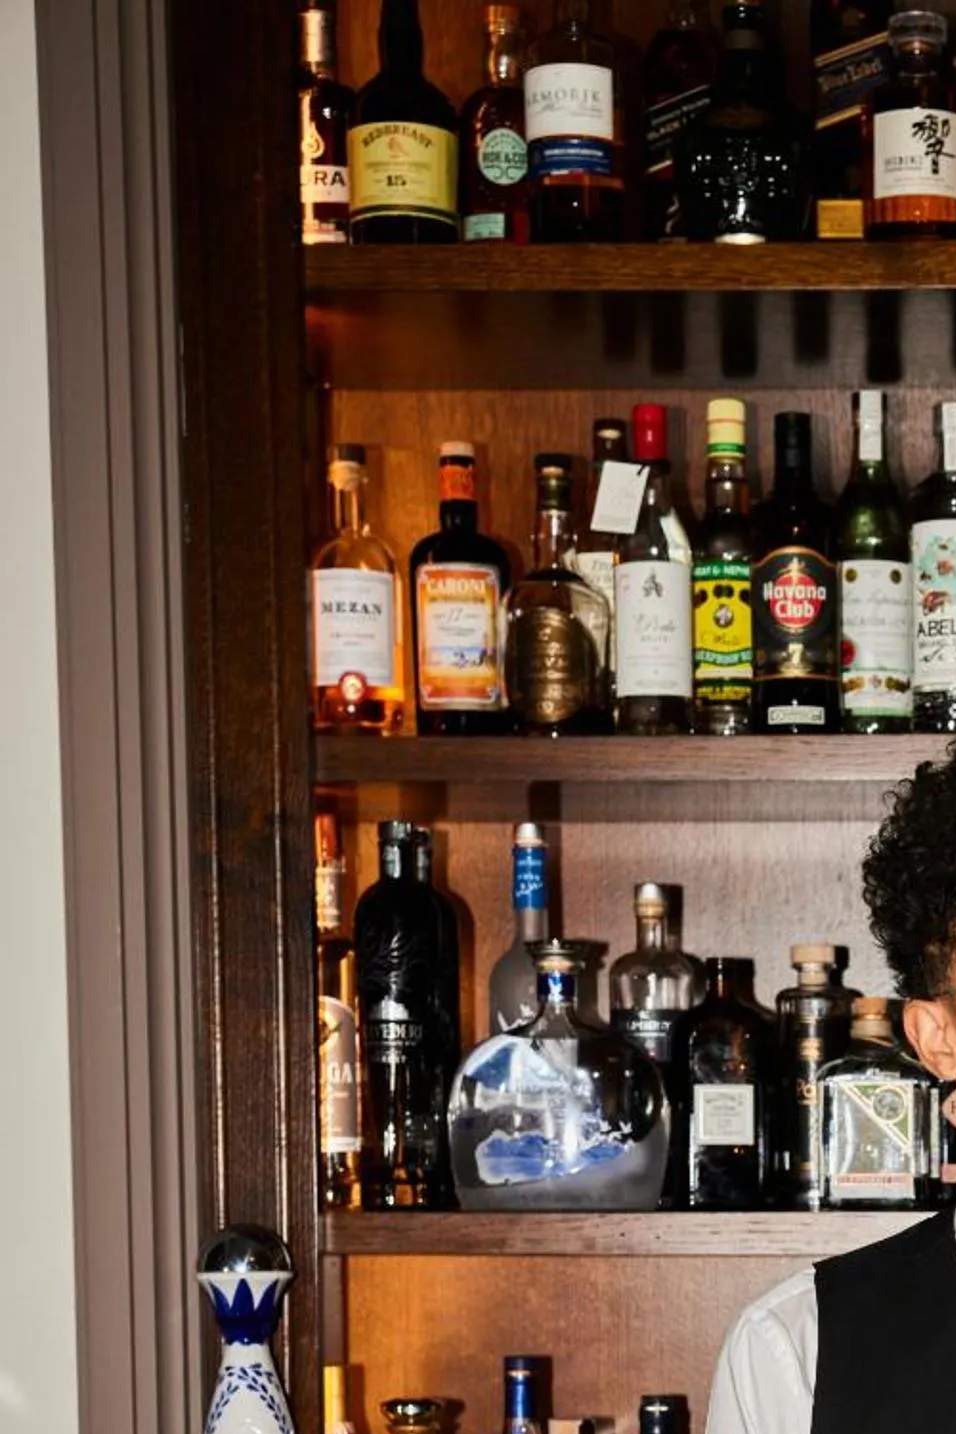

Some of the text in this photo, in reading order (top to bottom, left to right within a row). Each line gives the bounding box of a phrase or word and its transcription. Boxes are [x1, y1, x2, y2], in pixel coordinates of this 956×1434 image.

[361, 124, 432, 147] REDBREAST
[425, 579, 486, 597] CARONI
[763, 582, 827, 601] Havana
[320, 601, 382, 615] MEZAN
[775, 600, 815, 618] Club
[789, 643, 804, 665] 7
